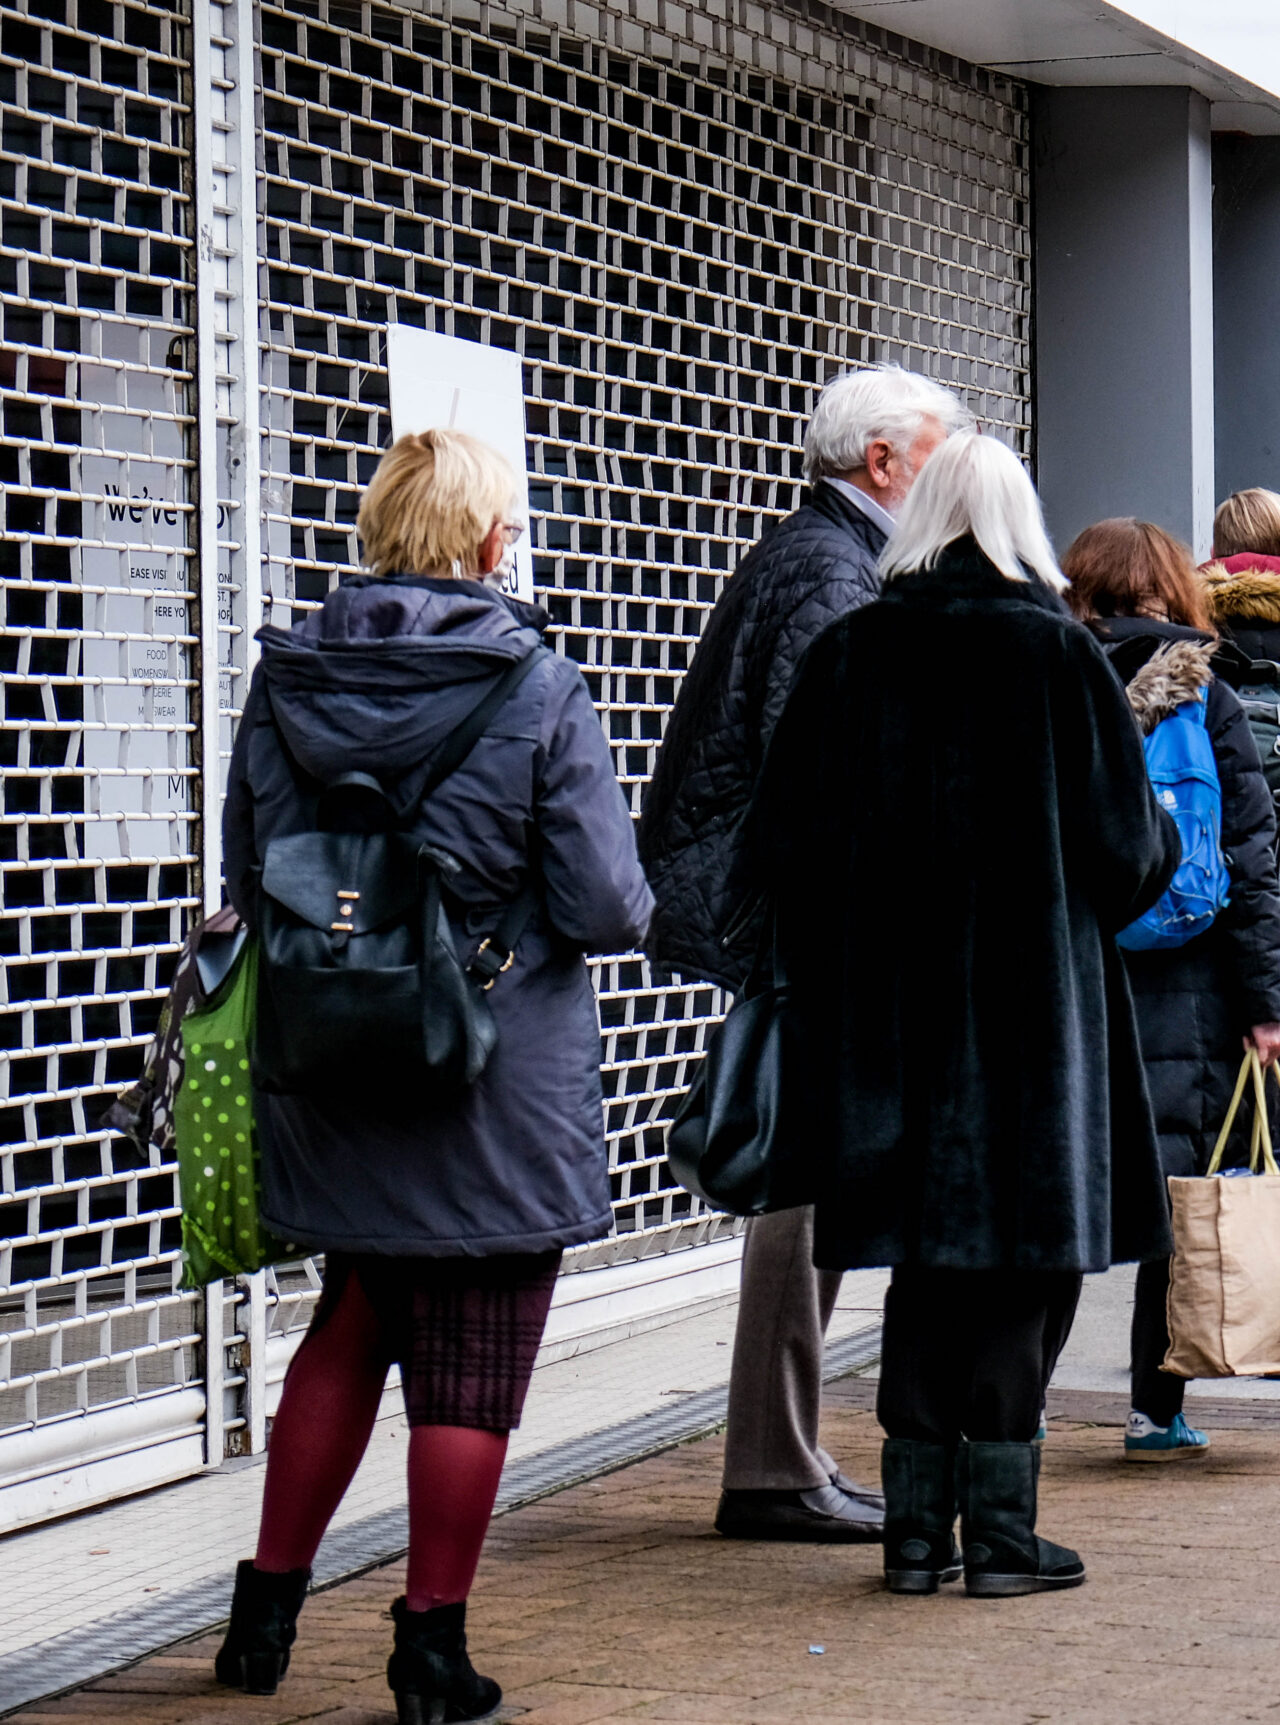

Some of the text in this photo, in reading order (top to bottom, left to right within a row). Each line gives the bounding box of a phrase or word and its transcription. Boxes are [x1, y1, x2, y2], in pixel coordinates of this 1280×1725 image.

[104, 483, 178, 526] We've
[130, 567, 150, 579] EASE
[152, 568, 167, 580] VISI
[154, 606, 172, 617] HERE
[146, 650, 167, 660] FOOD
[132, 668, 182, 679] WOMENSWR
[142, 687, 172, 698] LGERIE
[138, 707, 176, 717] MSWEAR
